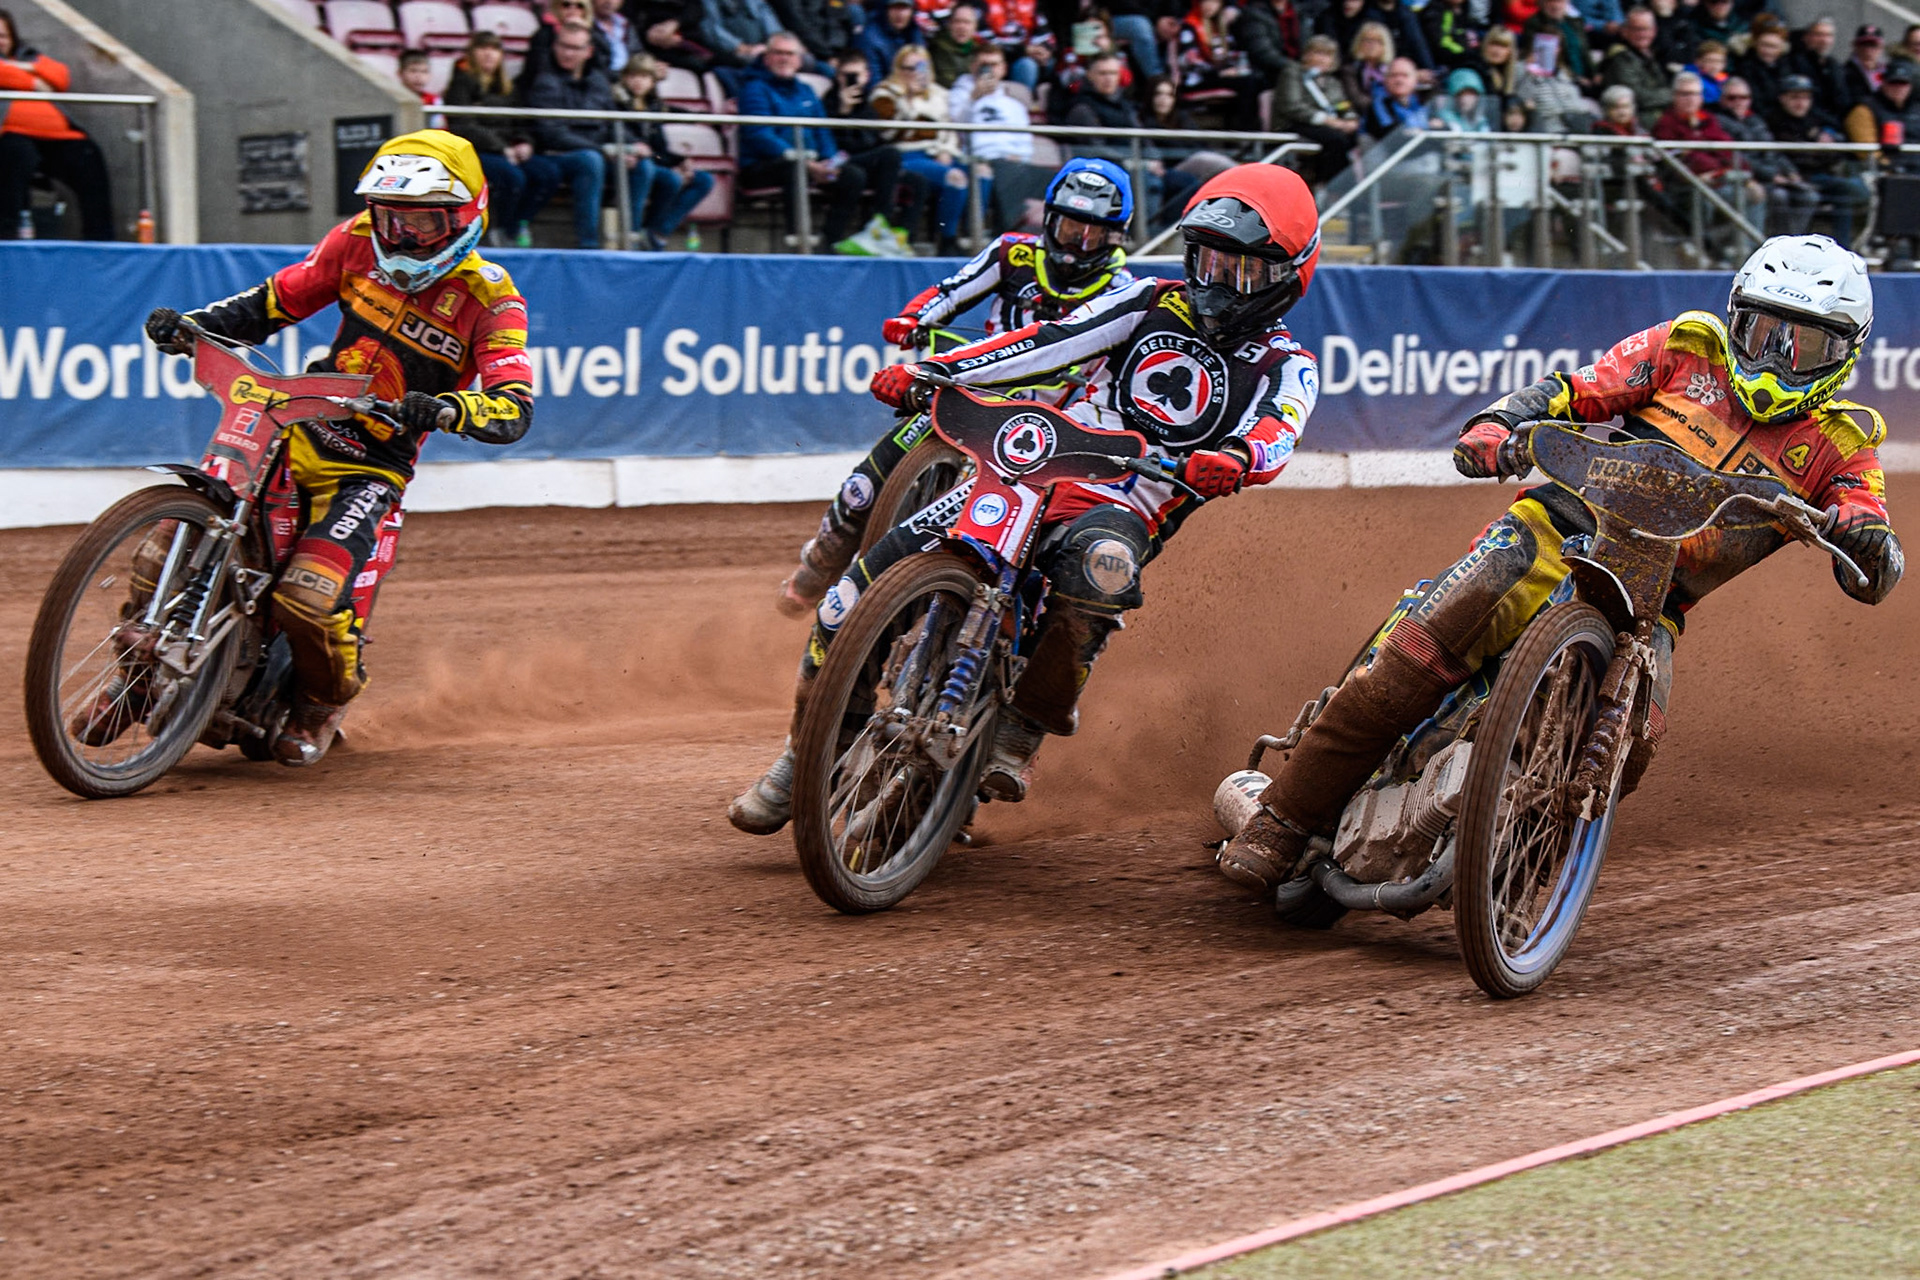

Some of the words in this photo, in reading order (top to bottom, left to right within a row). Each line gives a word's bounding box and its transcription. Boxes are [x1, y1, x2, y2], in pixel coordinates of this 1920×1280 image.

[436, 292, 459, 317] 1
[1773, 285, 1807, 302] Arai
[400, 319, 464, 363] JCB
[1237, 342, 1262, 362] 5
[1139, 338, 1186, 356] BELLE
[1191, 345, 1216, 367] VUE
[1210, 370, 1224, 404] ACES
[1687, 424, 1718, 449] JCB
[1784, 442, 1811, 469] 4
[1093, 553, 1131, 577] ATPI
[280, 567, 339, 597] JCB
